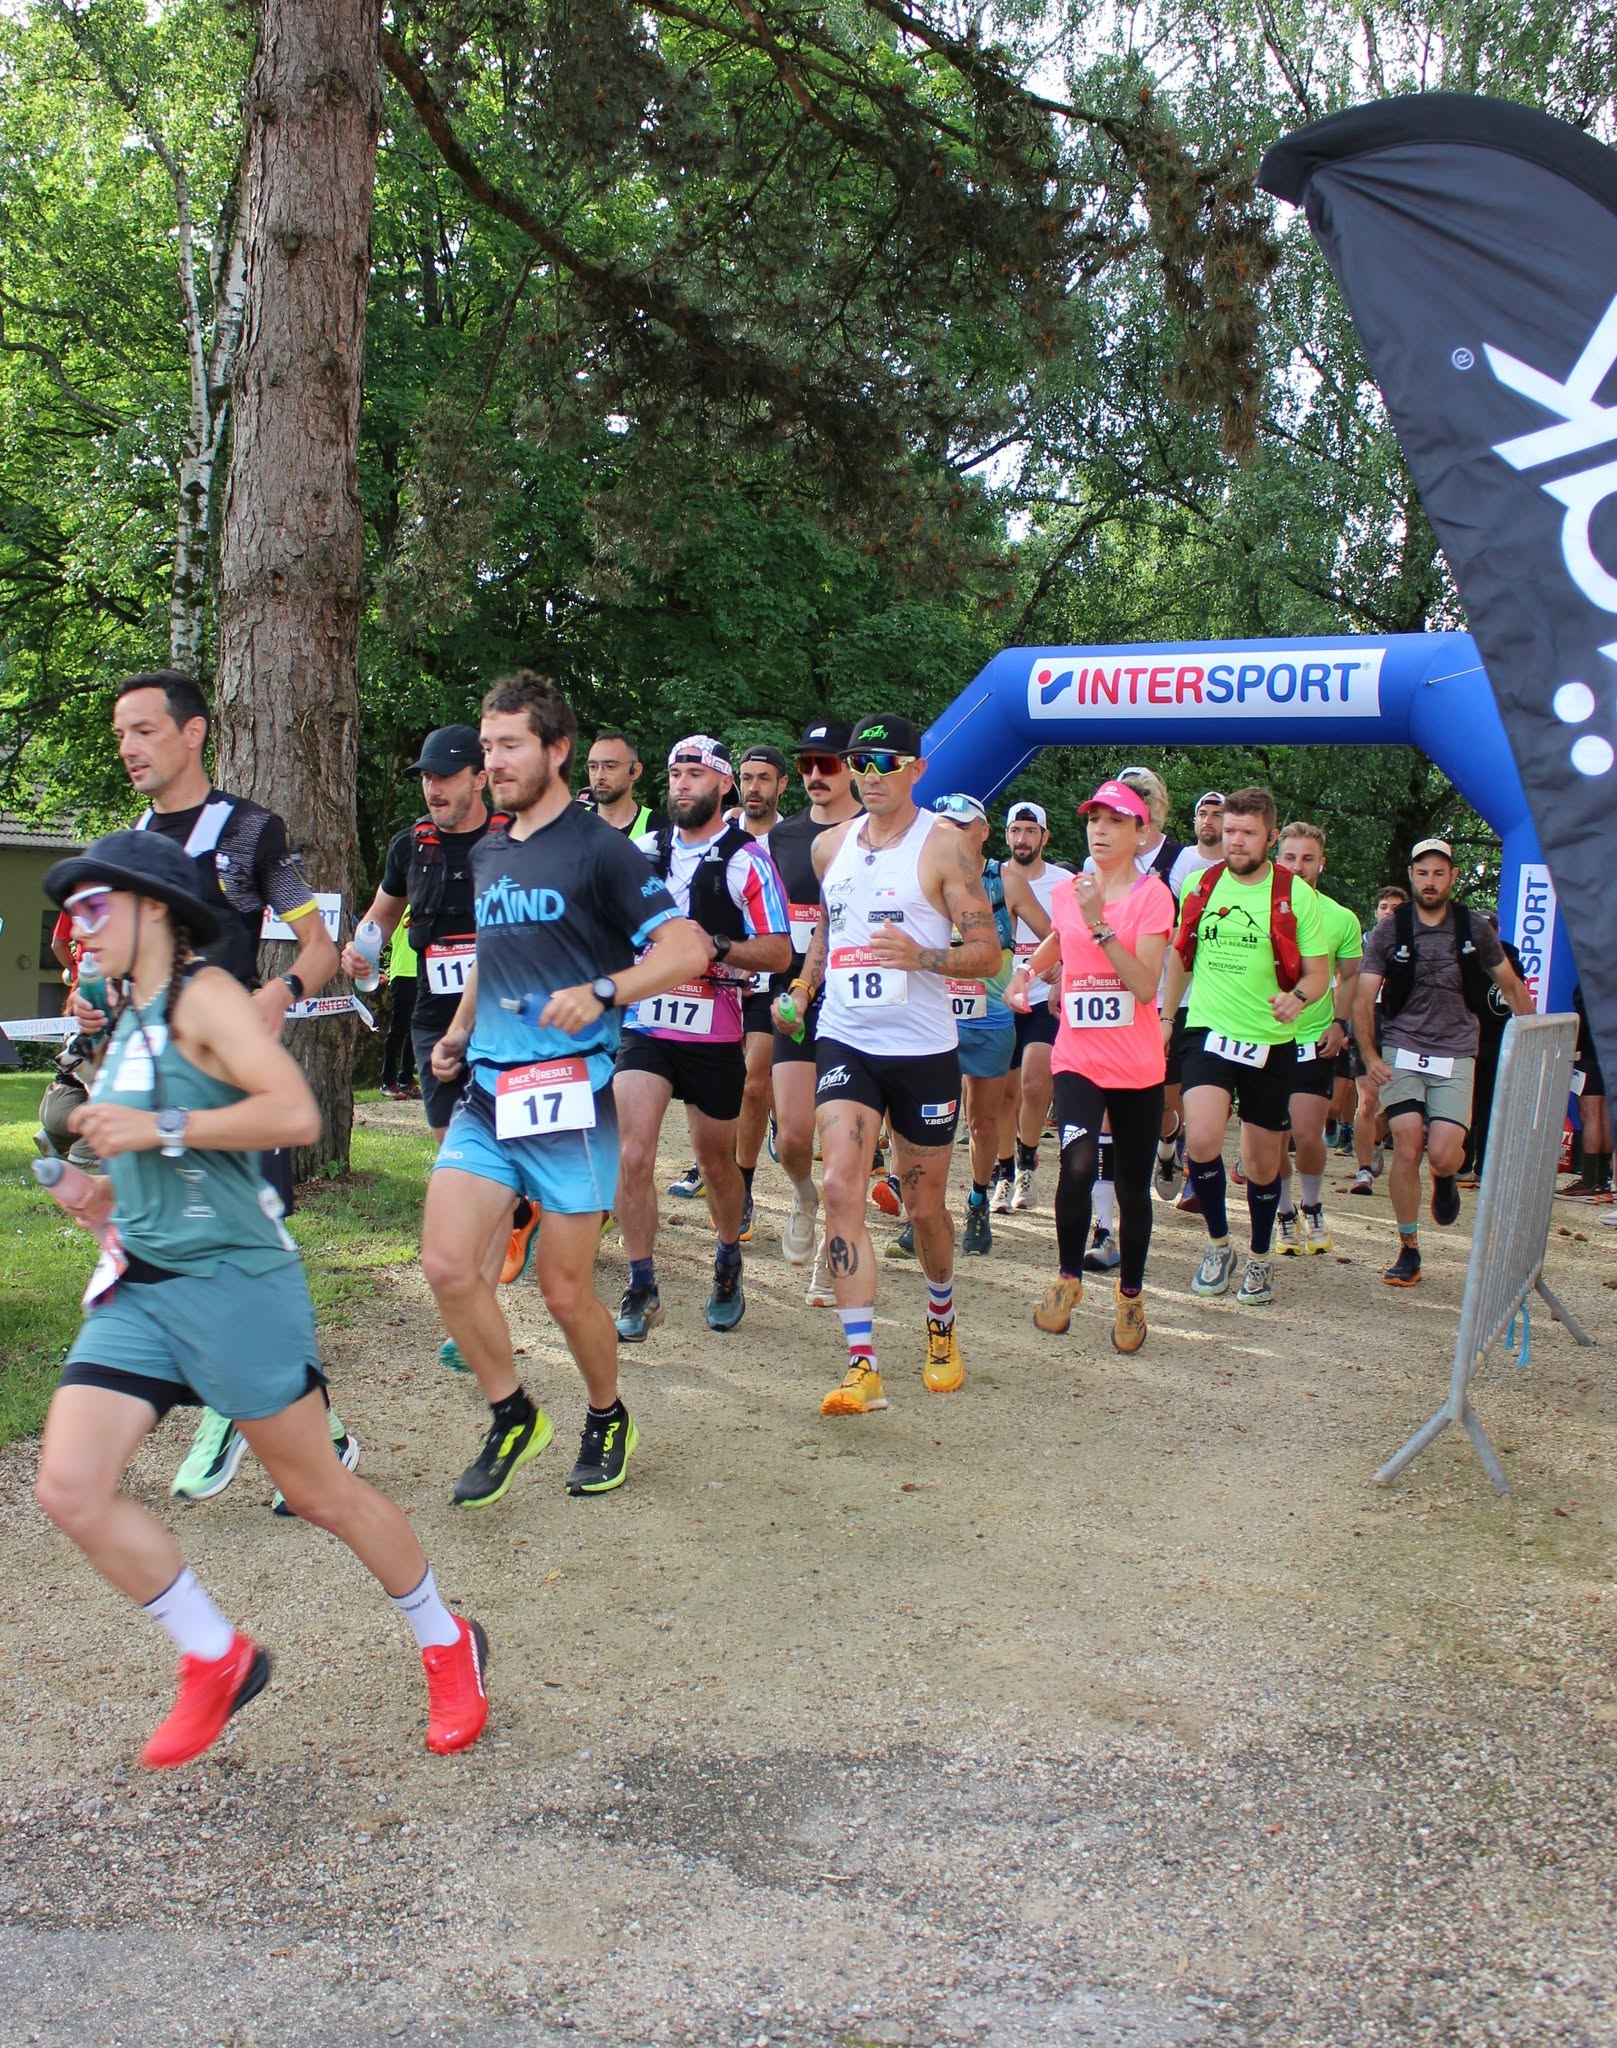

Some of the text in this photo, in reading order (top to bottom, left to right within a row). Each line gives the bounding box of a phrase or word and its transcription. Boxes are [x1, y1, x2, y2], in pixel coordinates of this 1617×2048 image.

[437, 961, 475, 987] 11
[848, 972, 882, 999] 18
[652, 998, 699, 1026] 117
[1074, 996, 1121, 1021] 103
[1219, 1036, 1258, 1060] 112
[1417, 1053, 1429, 1068] 5
[508, 1073, 531, 1086] RACE
[540, 1066, 573, 1080] RESULT
[522, 1091, 563, 1126] 17
